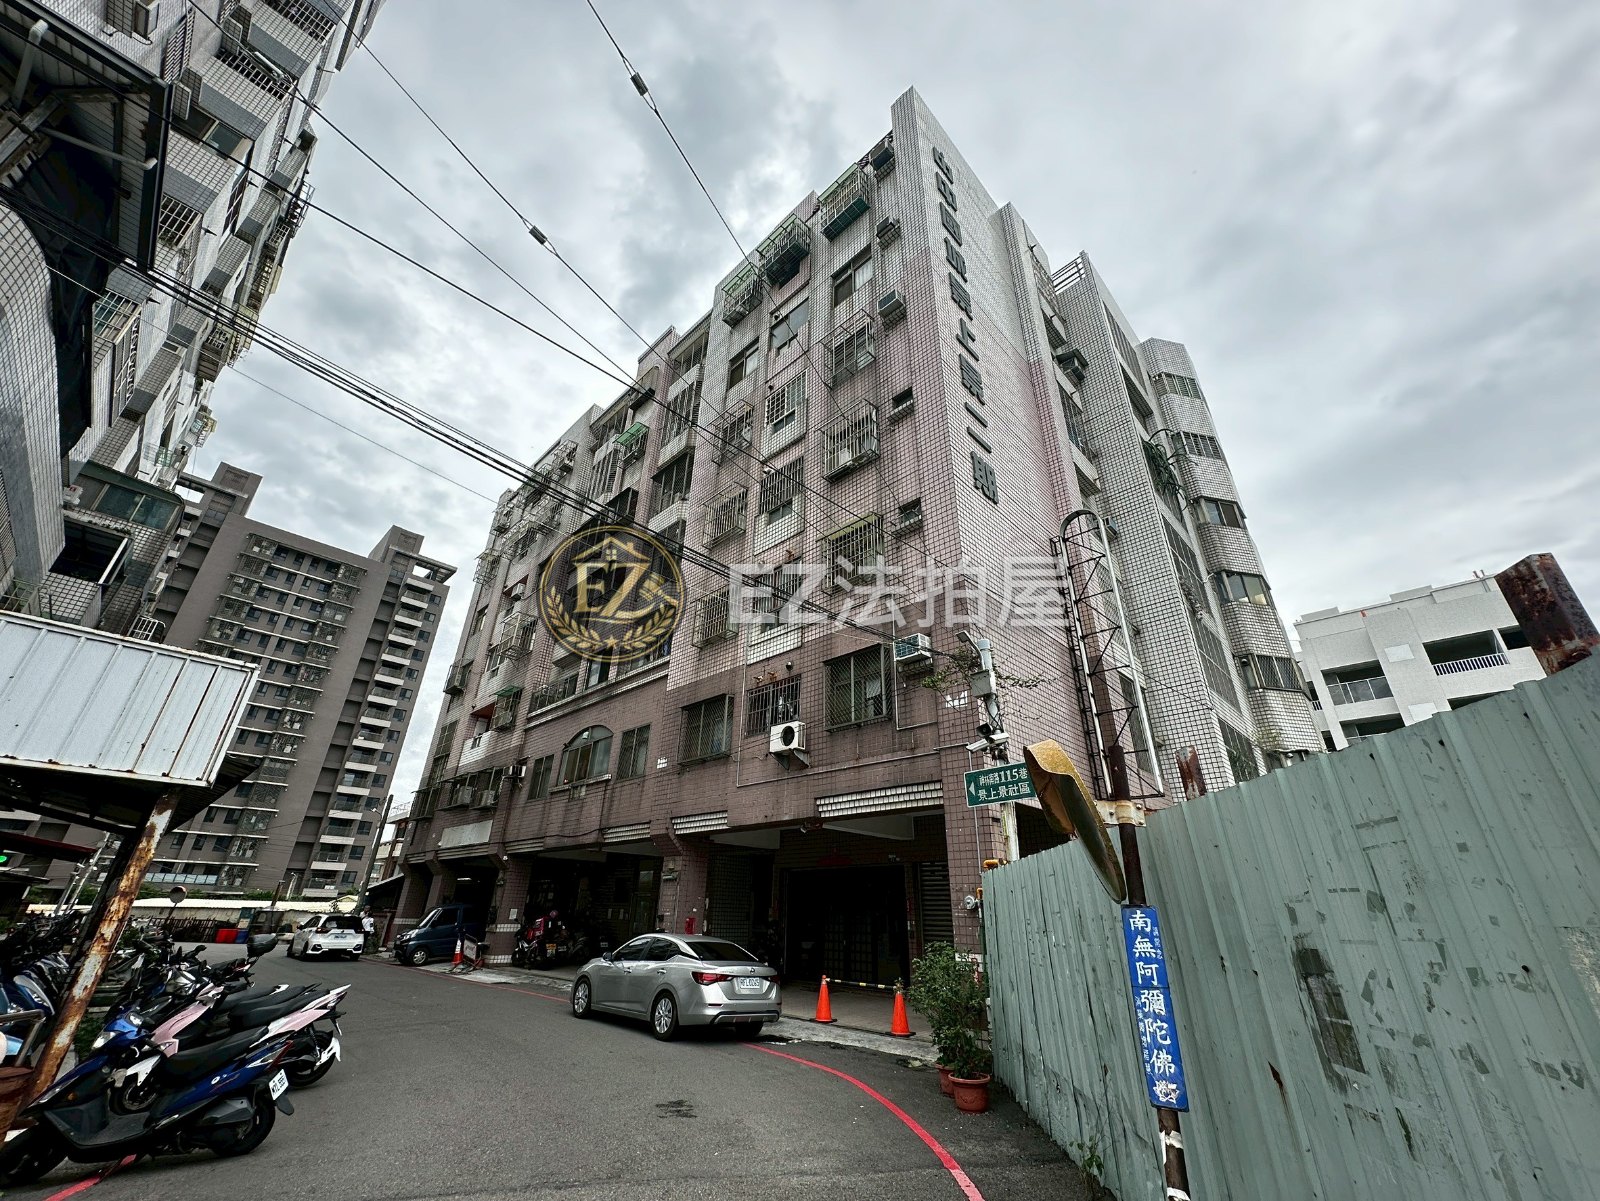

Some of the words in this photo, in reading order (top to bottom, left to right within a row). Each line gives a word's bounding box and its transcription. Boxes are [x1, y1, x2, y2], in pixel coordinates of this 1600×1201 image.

[978, 781, 1031, 801] 景上景社區
[1128, 909, 1176, 1077] 南無阿彌陀佛
